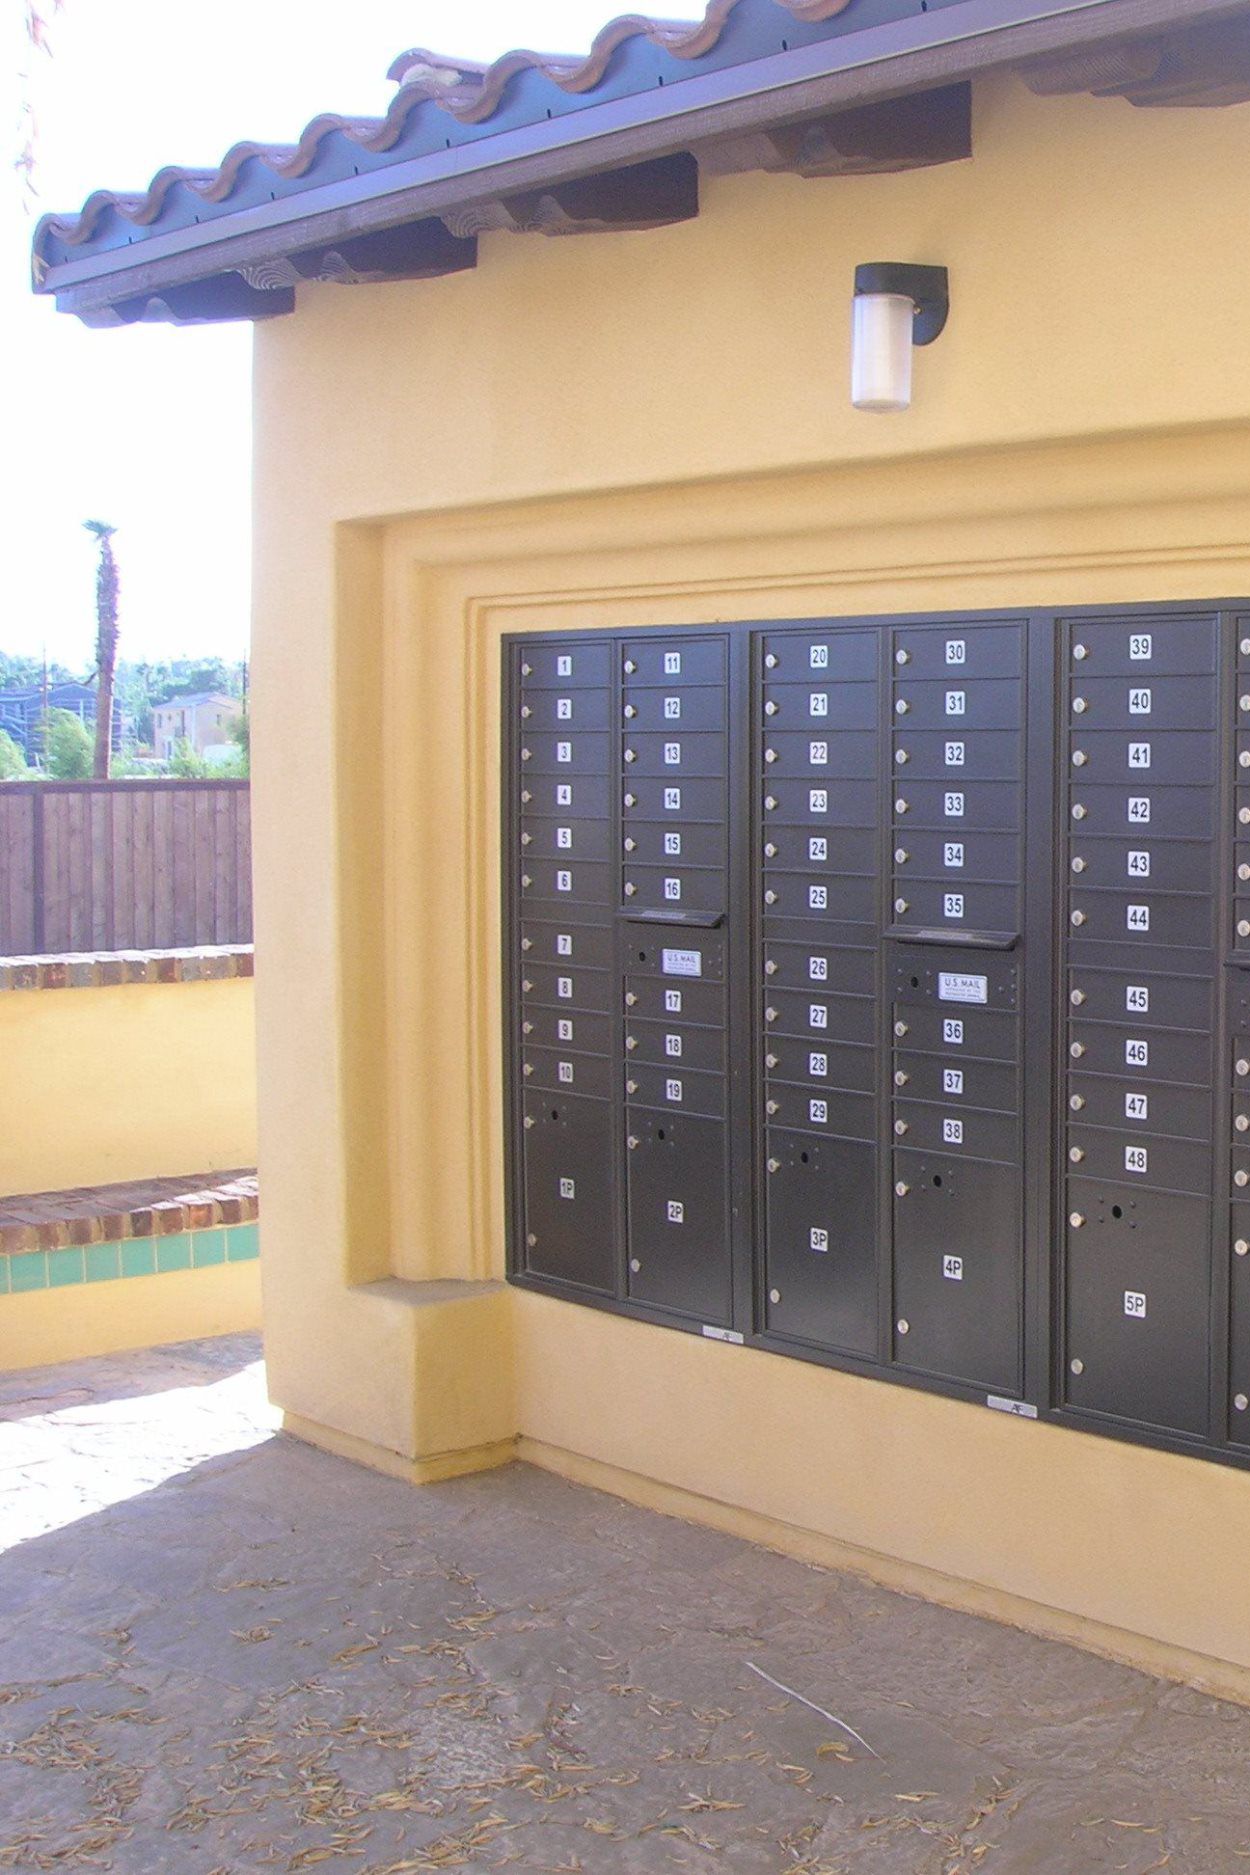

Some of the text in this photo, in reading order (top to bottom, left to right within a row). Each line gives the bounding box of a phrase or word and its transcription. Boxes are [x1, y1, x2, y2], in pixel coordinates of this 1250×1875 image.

[948, 644, 964, 661] 30
[1131, 637, 1150, 656] 39
[812, 648, 827, 664] 20
[666, 700, 679, 715] 12
[812, 696, 826, 712] 21
[948, 694, 963, 712] 31
[1131, 692, 1149, 710] 40
[666, 746, 679, 761] 13
[812, 744, 826, 760] 22
[947, 745, 963, 762] 32
[1131, 747, 1148, 764] 41
[666, 792, 679, 806] 14
[812, 793, 826, 809] 23
[946, 795, 962, 812] 33
[1130, 801, 1148, 819] 42
[666, 836, 679, 851] 15
[811, 841, 826, 857] 24
[946, 846, 962, 863] 34
[1130, 855, 1148, 873] 43
[666, 881, 679, 897] 16
[811, 889, 826, 906] 25
[946, 896, 962, 914] 35
[1129, 909, 1148, 927] 44
[679, 954, 696, 964] MAIL
[811, 959, 826, 976] 26
[961, 979, 981, 989] MAIL
[667, 993, 680, 1008] 17
[1128, 990, 1147, 1008] 45
[812, 1008, 826, 1024] 27
[945, 1022, 962, 1039] 36
[667, 1038, 680, 1053] 18
[1128, 1044, 1146, 1062] 46
[560, 1065, 572, 1080] 10
[811, 1056, 826, 1072] 28
[946, 1072, 962, 1089] 37
[668, 1082, 681, 1098] 19
[812, 1102, 826, 1119] 29
[1127, 1097, 1145, 1115] 47
[945, 1122, 961, 1140] 38
[1127, 1150, 1145, 1169] 48
[561, 1181, 574, 1195] 1P
[669, 1204, 682, 1219] 2P
[812, 1230, 827, 1247] 3P
[945, 1259, 962, 1275] 4P
[1126, 1295, 1144, 1313] 5P
